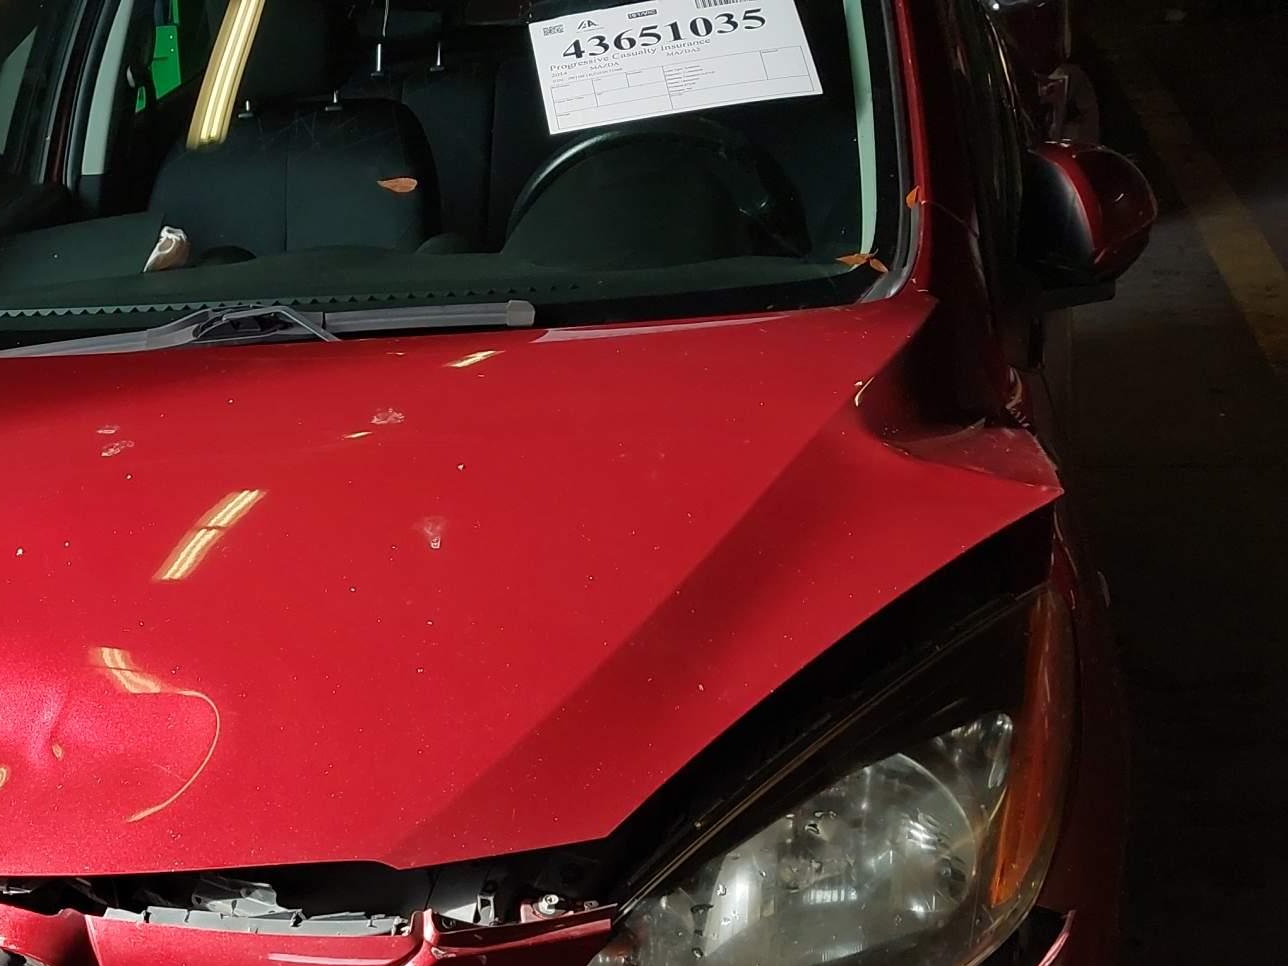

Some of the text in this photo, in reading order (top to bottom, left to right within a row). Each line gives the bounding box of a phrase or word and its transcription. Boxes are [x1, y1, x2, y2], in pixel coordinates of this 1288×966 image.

[562, 8, 766, 59] 43651035
[550, 38, 711, 72] Progressive Casualty Insurance
[590, 61, 620, 71] MAZDA
